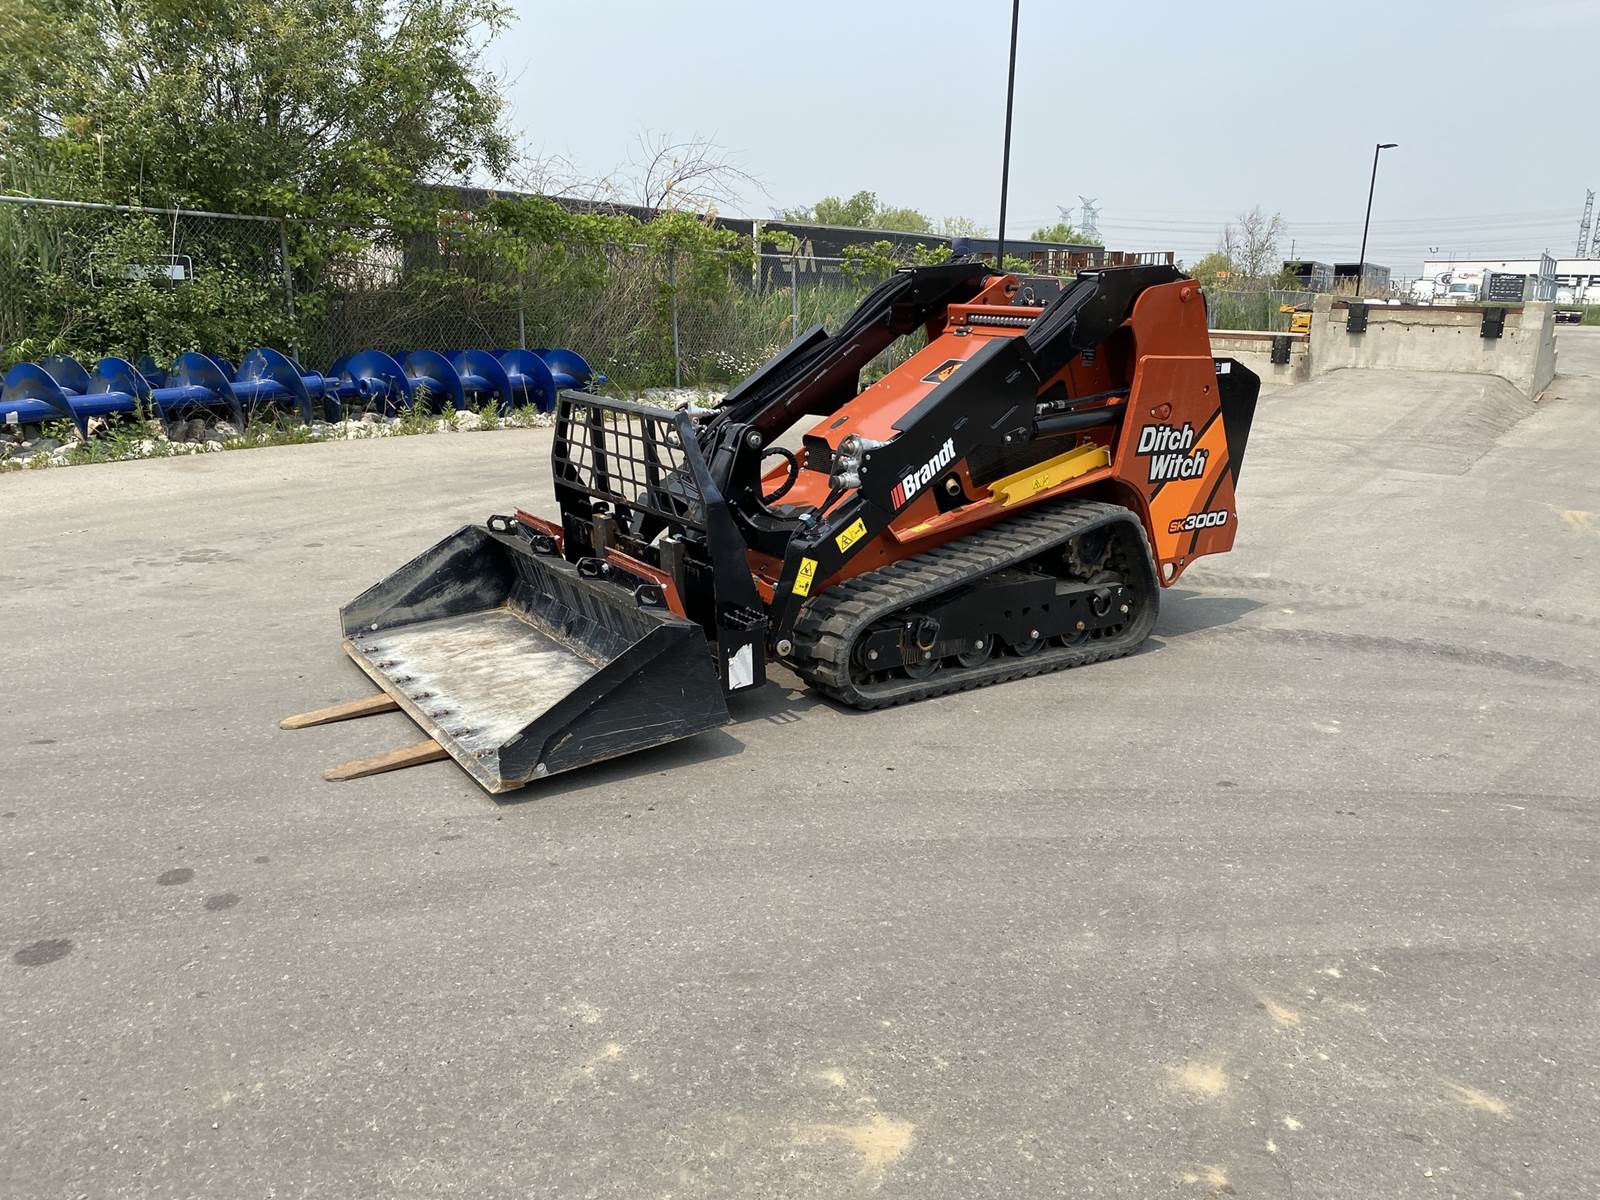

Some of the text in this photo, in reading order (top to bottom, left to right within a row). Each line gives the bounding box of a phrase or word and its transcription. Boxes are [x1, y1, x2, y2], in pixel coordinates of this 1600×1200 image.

[1137, 424, 1194, 453] Ditch
[901, 437, 956, 500] Brandt
[1150, 451, 1206, 480] Witch
[1169, 510, 1228, 533] SK3000
